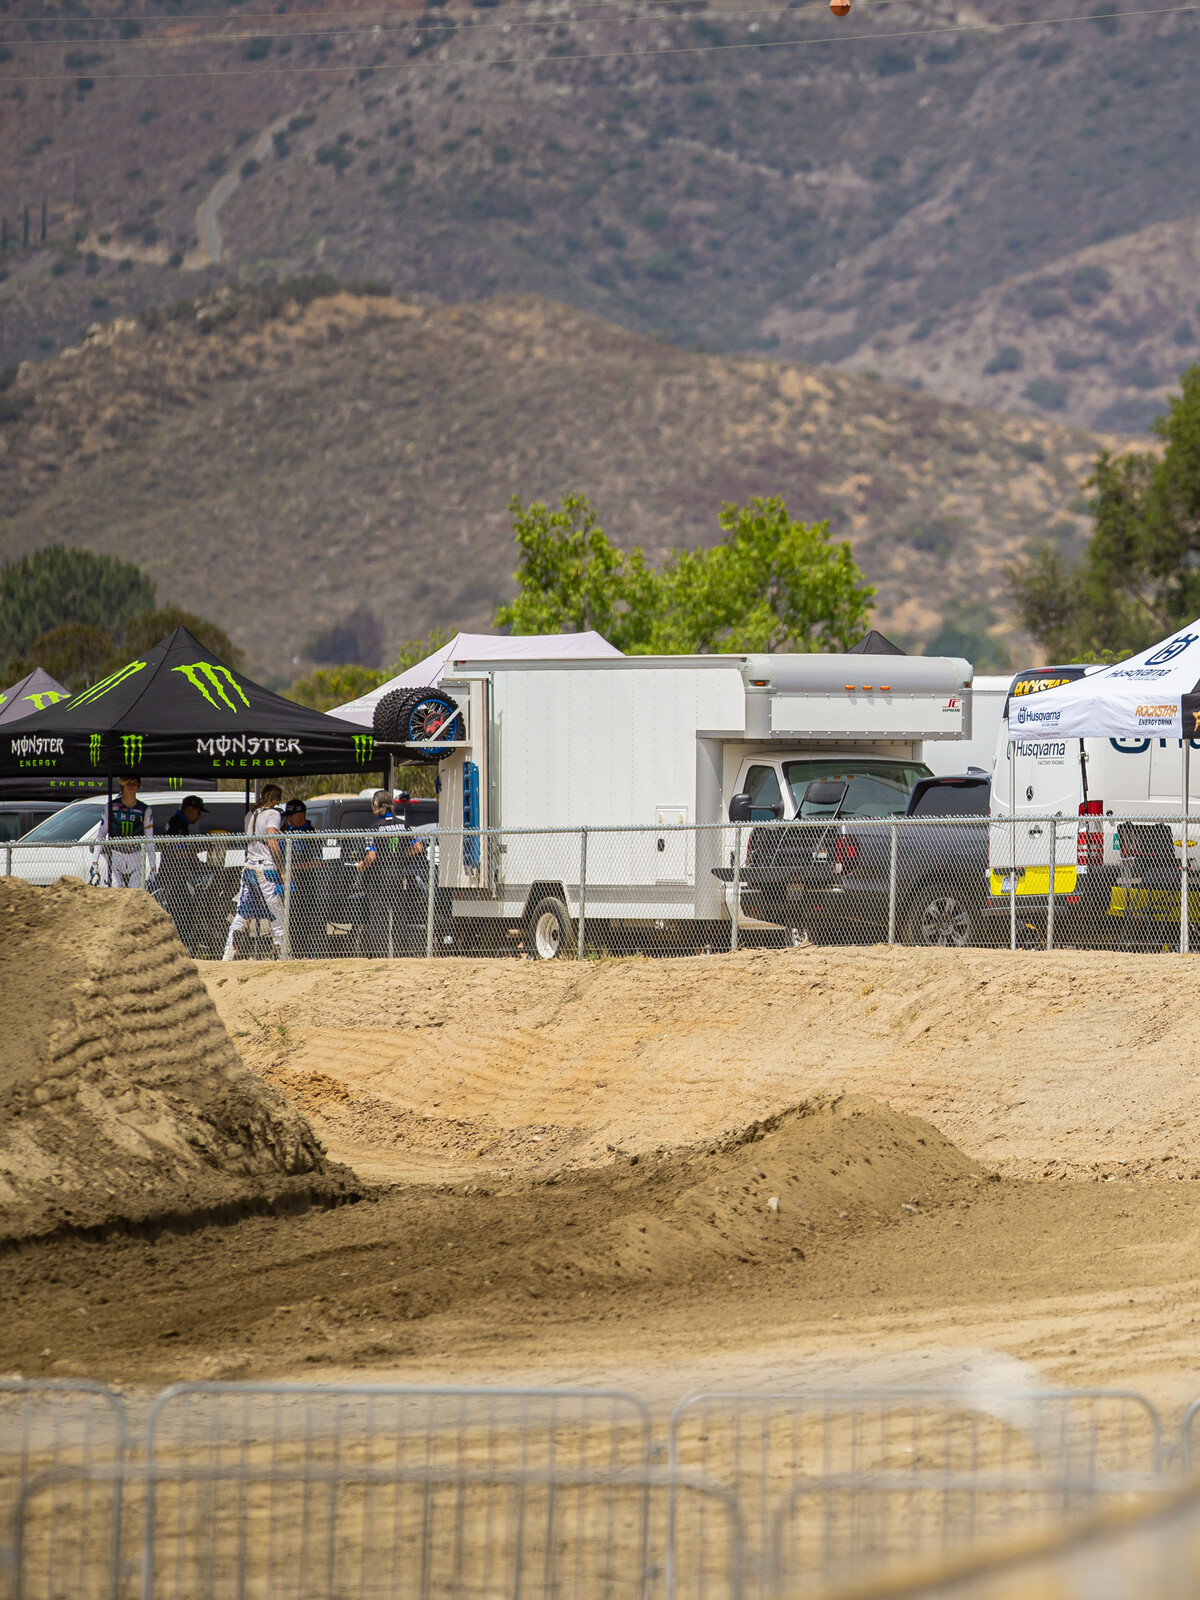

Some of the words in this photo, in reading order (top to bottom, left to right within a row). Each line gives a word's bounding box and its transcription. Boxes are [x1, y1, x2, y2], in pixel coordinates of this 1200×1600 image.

[1026, 711, 1061, 723] Husqvarna
[1135, 704, 1178, 718] ROCKSTAR
[1139, 718, 1157, 726] ENERGY
[1158, 718, 1172, 726] DRINK
[11, 734, 64, 757] MONSTER
[196, 734, 303, 756] MONSTER
[1016, 741, 1066, 759] Husqvarna
